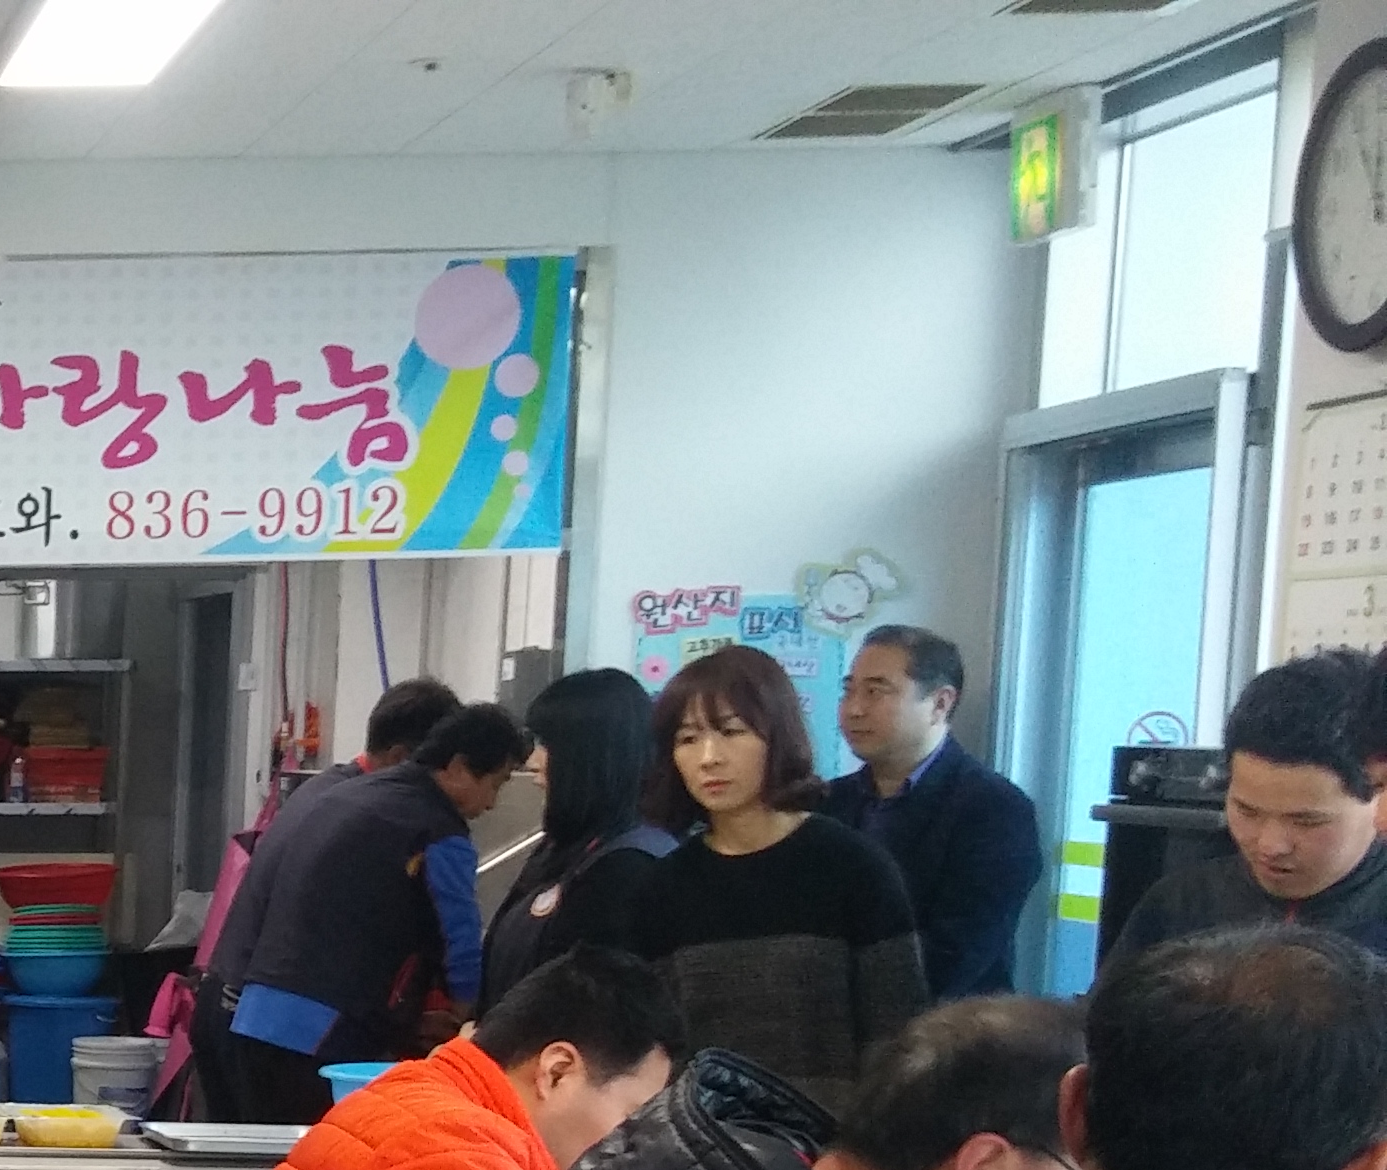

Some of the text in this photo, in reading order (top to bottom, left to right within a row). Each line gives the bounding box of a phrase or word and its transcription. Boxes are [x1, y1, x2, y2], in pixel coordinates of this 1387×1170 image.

[104, 487, 402, 539] 836-9912
[637, 589, 801, 635] 원산지 표시
